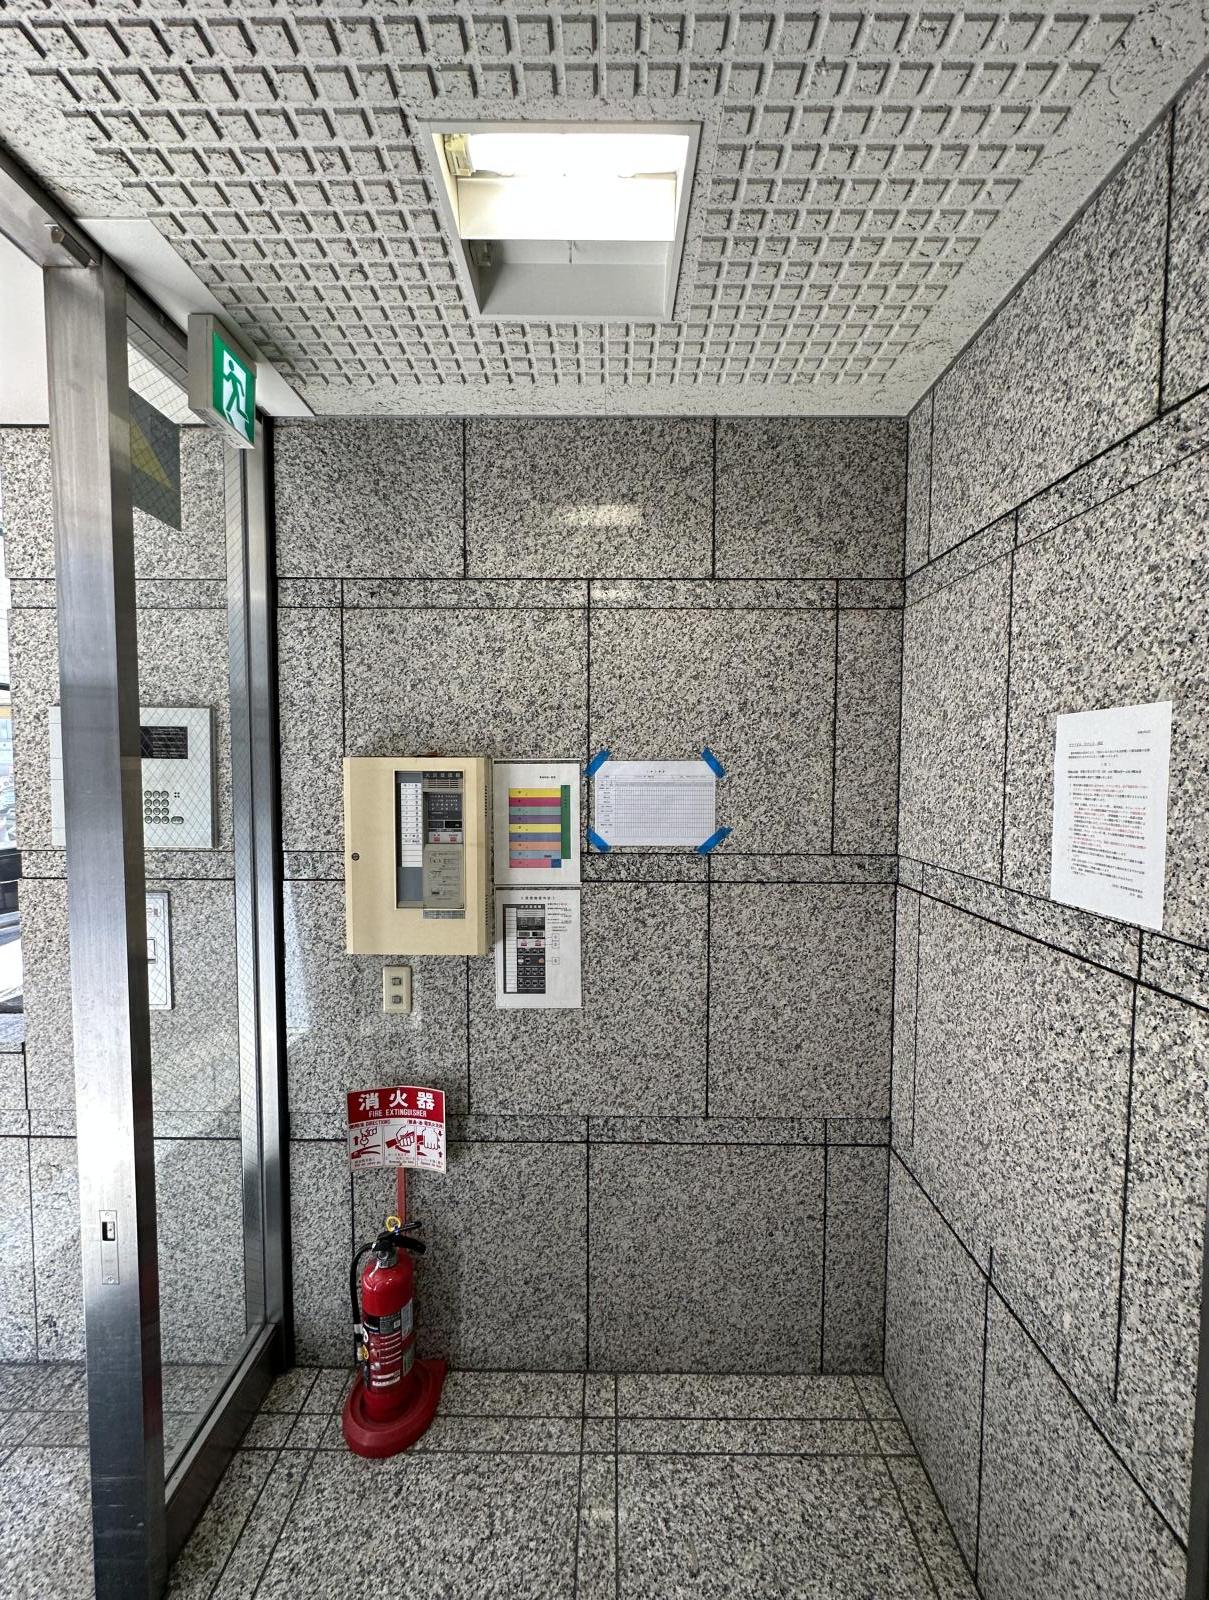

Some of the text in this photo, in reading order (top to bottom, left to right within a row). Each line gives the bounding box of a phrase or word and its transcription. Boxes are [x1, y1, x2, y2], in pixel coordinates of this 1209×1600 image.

[358, 1090, 435, 1111] 消火器
[368, 1108, 427, 1118] FIRE EXTINGUISHER
